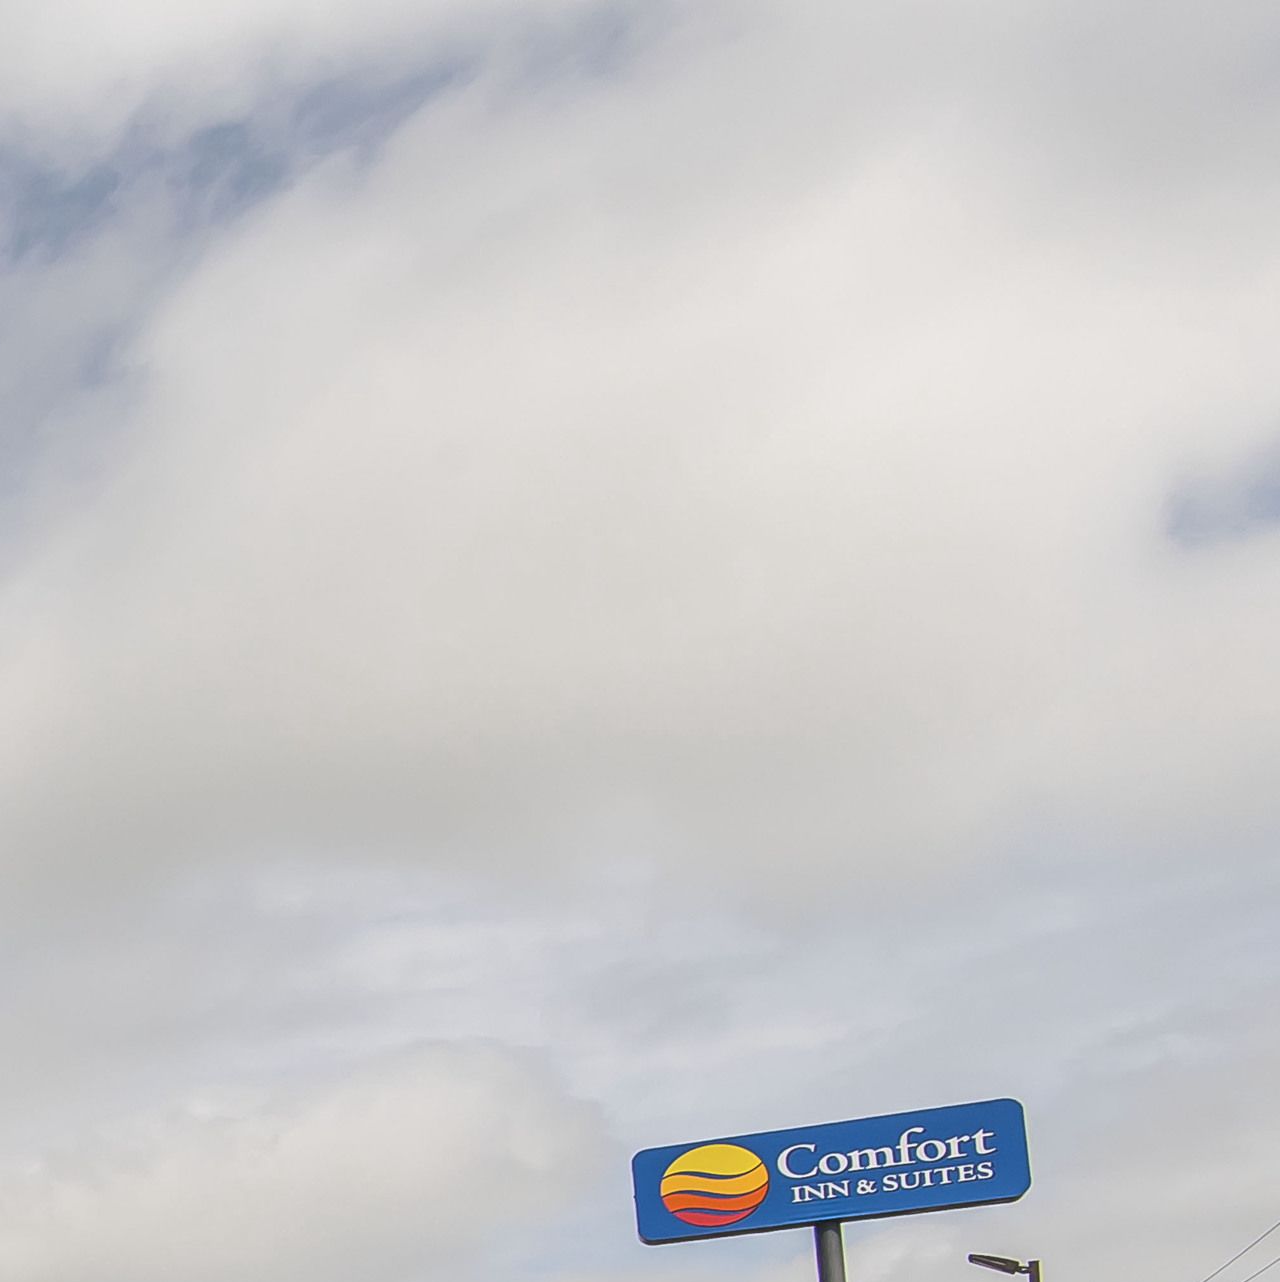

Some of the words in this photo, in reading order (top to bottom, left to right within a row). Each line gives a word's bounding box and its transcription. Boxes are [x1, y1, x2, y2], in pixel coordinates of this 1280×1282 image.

[777, 1127, 996, 1178] Comfort
[791, 1180, 849, 1203] INN
[856, 1179, 877, 1194] &
[882, 1162, 994, 1191] SUITES
